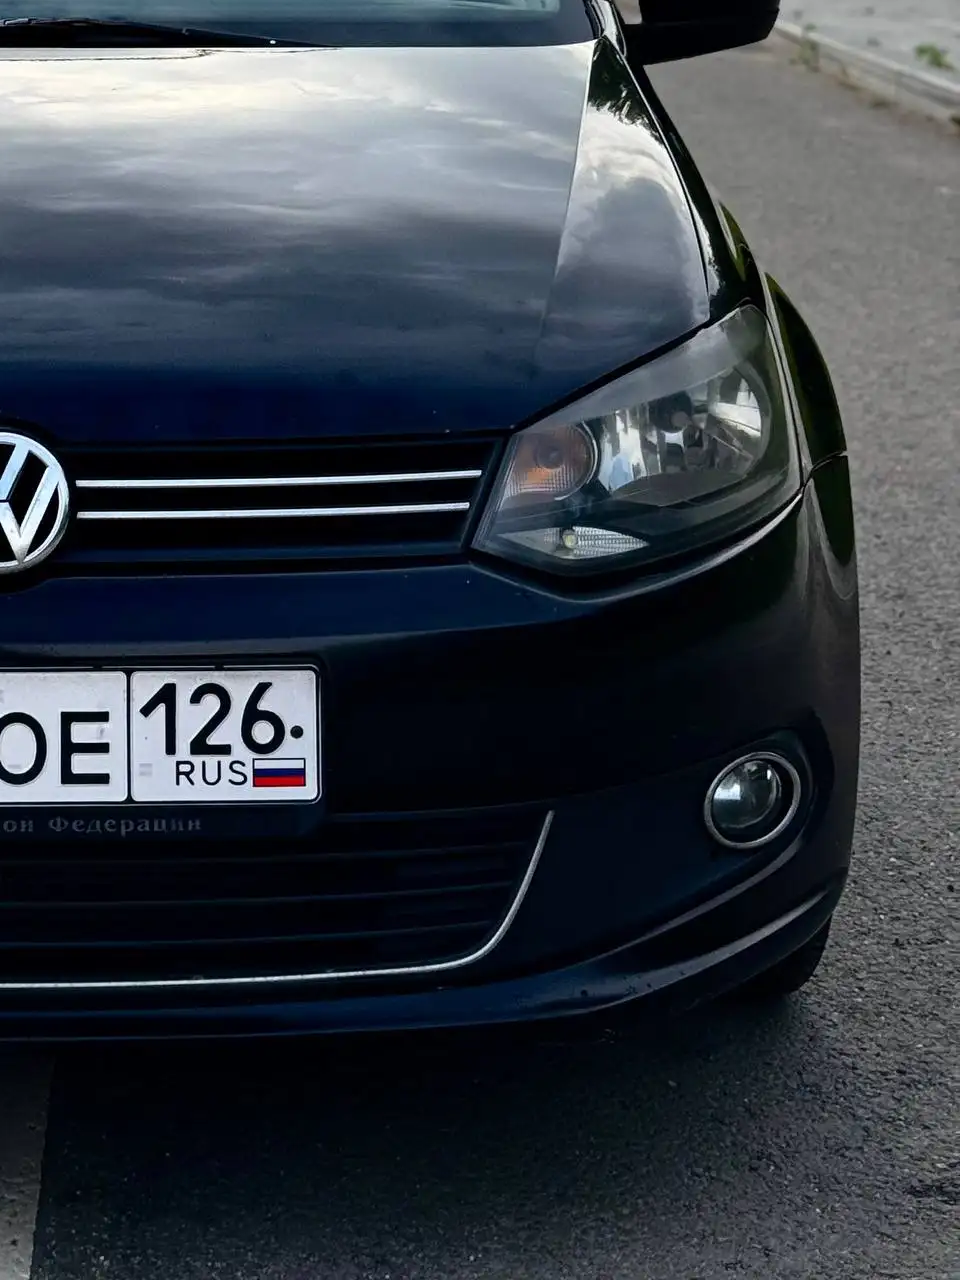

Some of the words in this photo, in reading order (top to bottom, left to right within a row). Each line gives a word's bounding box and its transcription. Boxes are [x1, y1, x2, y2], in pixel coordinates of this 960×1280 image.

[139, 682, 286, 756] 126
[175, 760, 248, 786] RUS
[47, 815, 202, 836] Федерации
